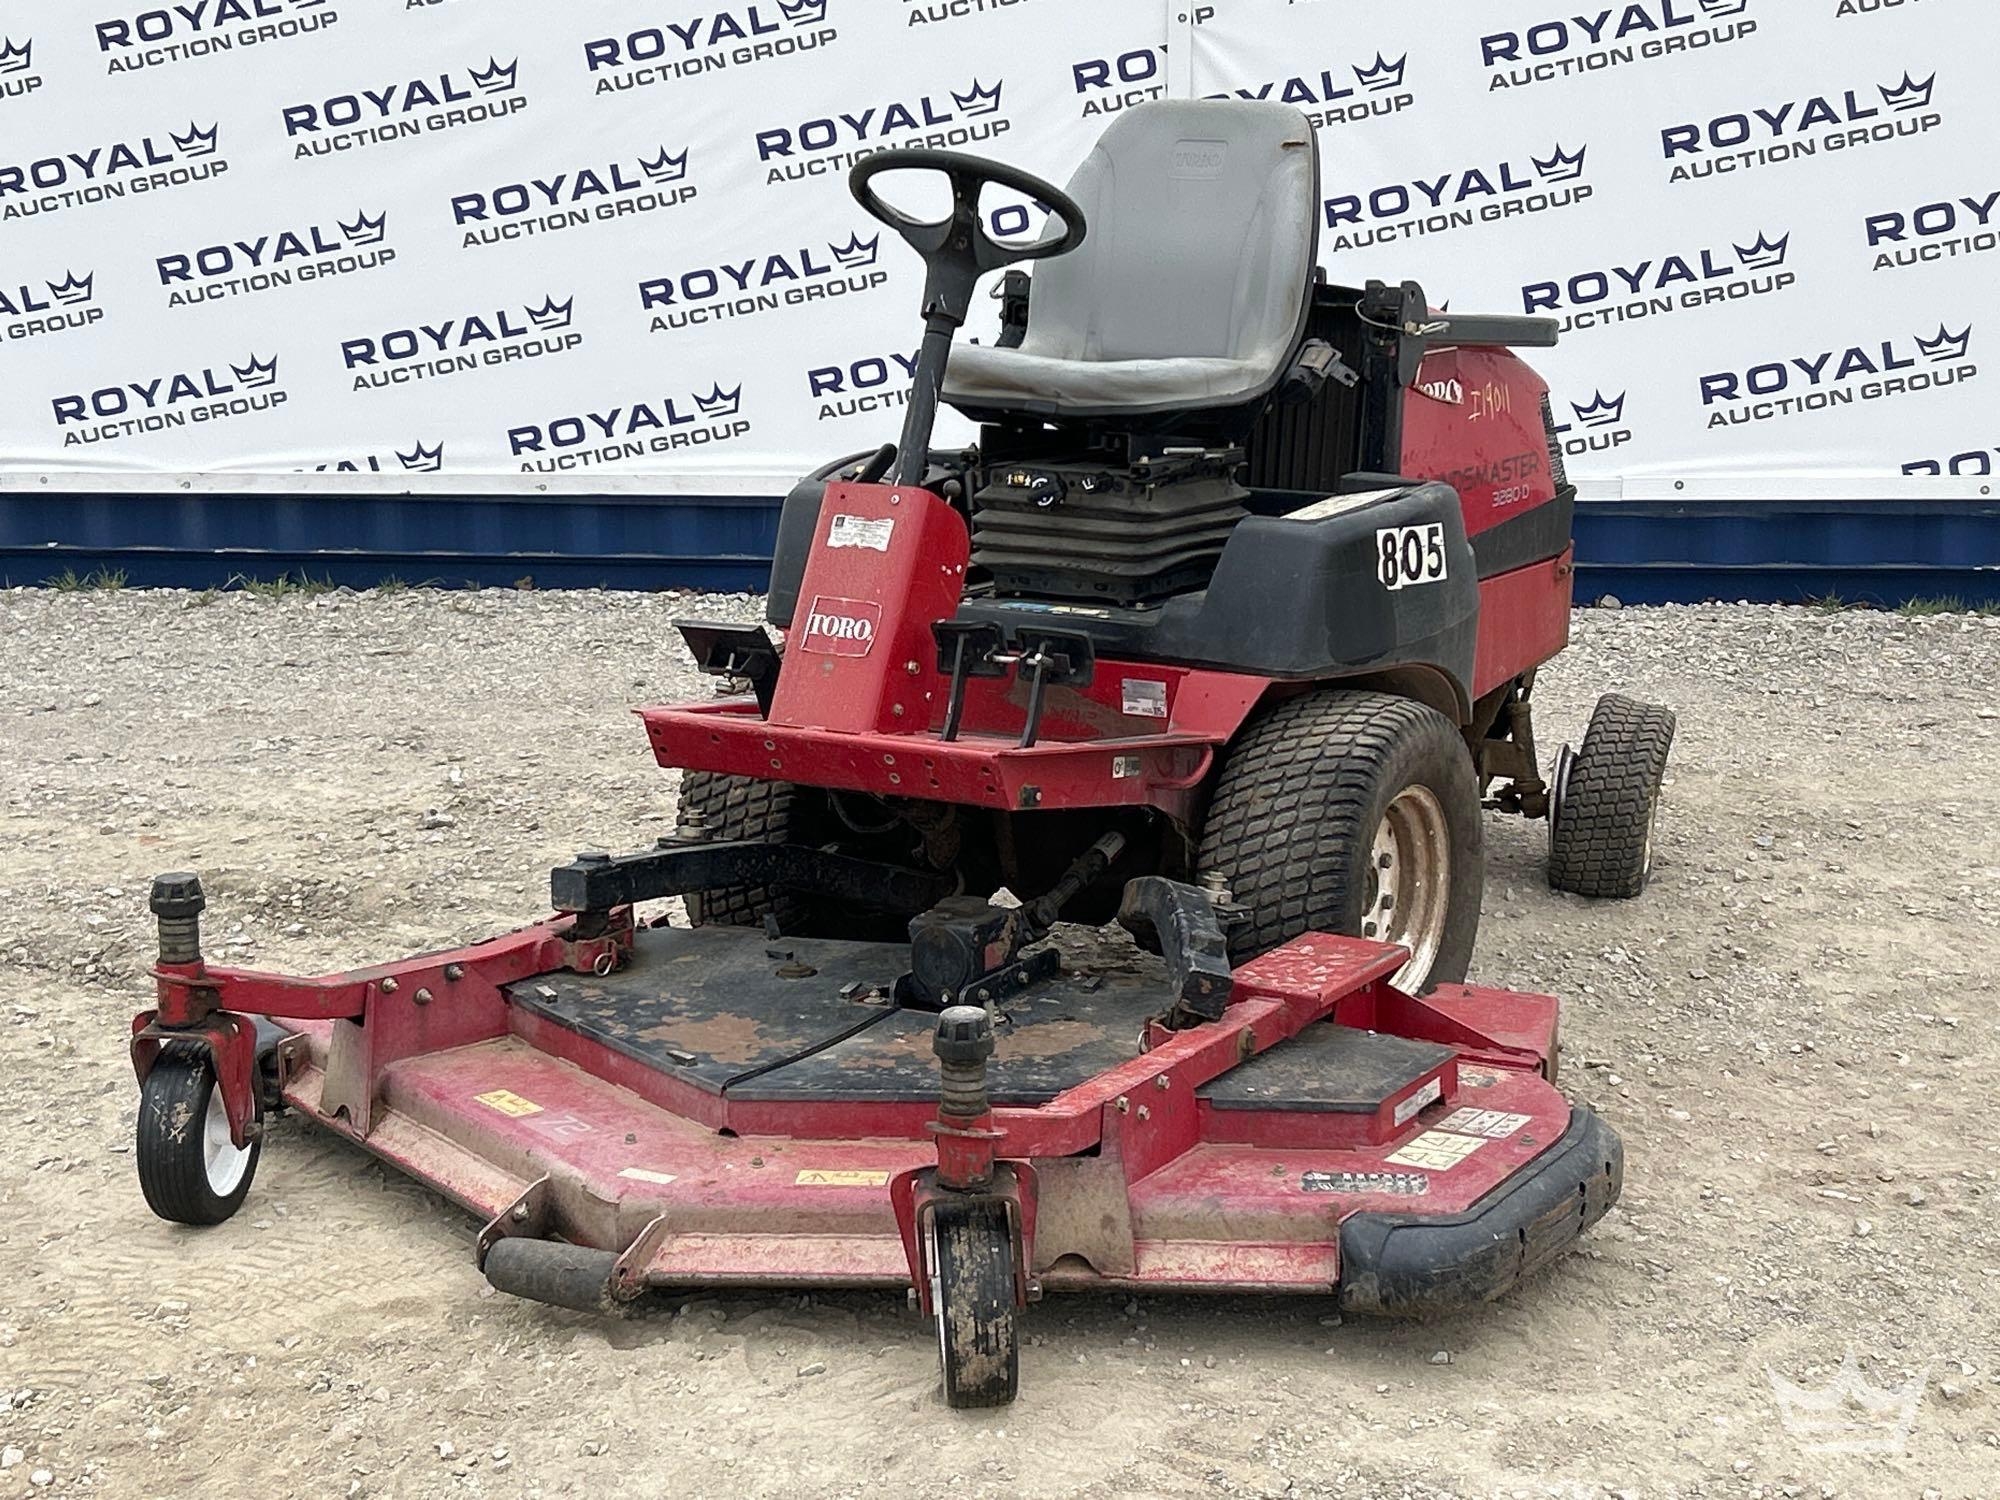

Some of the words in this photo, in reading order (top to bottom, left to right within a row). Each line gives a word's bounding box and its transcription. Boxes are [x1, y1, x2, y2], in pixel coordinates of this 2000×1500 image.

[95, 0, 282, 51] ROYAL
[108, 34, 232, 74] AUCTION
[238, 11, 337, 45] GROUP
[584, 6, 780, 71] ROYAL
[1480, 0, 1694, 66] ROYAL
[596, 53, 726, 95] AUCTION
[733, 29, 837, 64] GROUP
[1489, 46, 1633, 91] AUCTION
[1641, 21, 1757, 58] GROUP
[282, 74, 472, 136] ROYAL
[1082, 84, 1168, 117] AUCT
[1202, 71, 1354, 104] YAL
[1307, 94, 1413, 129] GROUP
[295, 119, 420, 159] AUCTION
[426, 97, 527, 130] GROUP
[756, 97, 953, 161] ROYAL
[905, 120, 1010, 151] GROUP
[1661, 91, 1878, 158] ROYAL
[1670, 139, 1816, 183] AUCTION
[1824, 114, 1941, 151] GROUP
[0, 138, 173, 197] ROYAL
[3, 182, 125, 220] AUCTION
[131, 160, 228, 193] GROUP
[451, 164, 641, 225] ROYAL
[1324, 162, 1532, 228] ROYAL
[463, 209, 589, 248] AUCTION
[595, 186, 697, 220] GROUP
[1333, 210, 1473, 252] AUCTION
[1480, 185, 1592, 221] GROUP
[1865, 191, 2000, 246] ROY
[156, 227, 341, 285] ROYAL
[169, 270, 291, 308] AUCTION
[297, 249, 395, 281] GROUP
[639, 249, 831, 310] ROYAL
[1873, 231, 2000, 271] AUCTIO
[650, 293, 778, 332] AUCTION
[785, 272, 887, 304] GROUP
[1522, 250, 1733, 314] ROYAL
[1558, 296, 1672, 333] UCTION
[1681, 272, 1795, 308] GROUP
[8, 308, 103, 339] GROUP
[341, 311, 528, 369] ROYAL
[353, 354, 477, 391] AUCTION
[483, 333, 582, 365] GROUP
[808, 349, 921, 397] ROY
[1416, 379, 1463, 404] ORO
[1700, 341, 1915, 405] ROYAL
[52, 368, 233, 425] ROYAL
[64, 411, 185, 447] AUCTION
[191, 391, 287, 422] GROUP
[819, 388, 912, 420] AUCTI
[1708, 388, 1853, 429] AUCTION
[1861, 365, 1976, 400] GROUP
[508, 399, 695, 456] ROYAL
[521, 441, 644, 472] AUCTION
[650, 421, 750, 452] GROUP
[1565, 430, 1631, 455] OUP
[1382, 526, 1443, 586] 805
